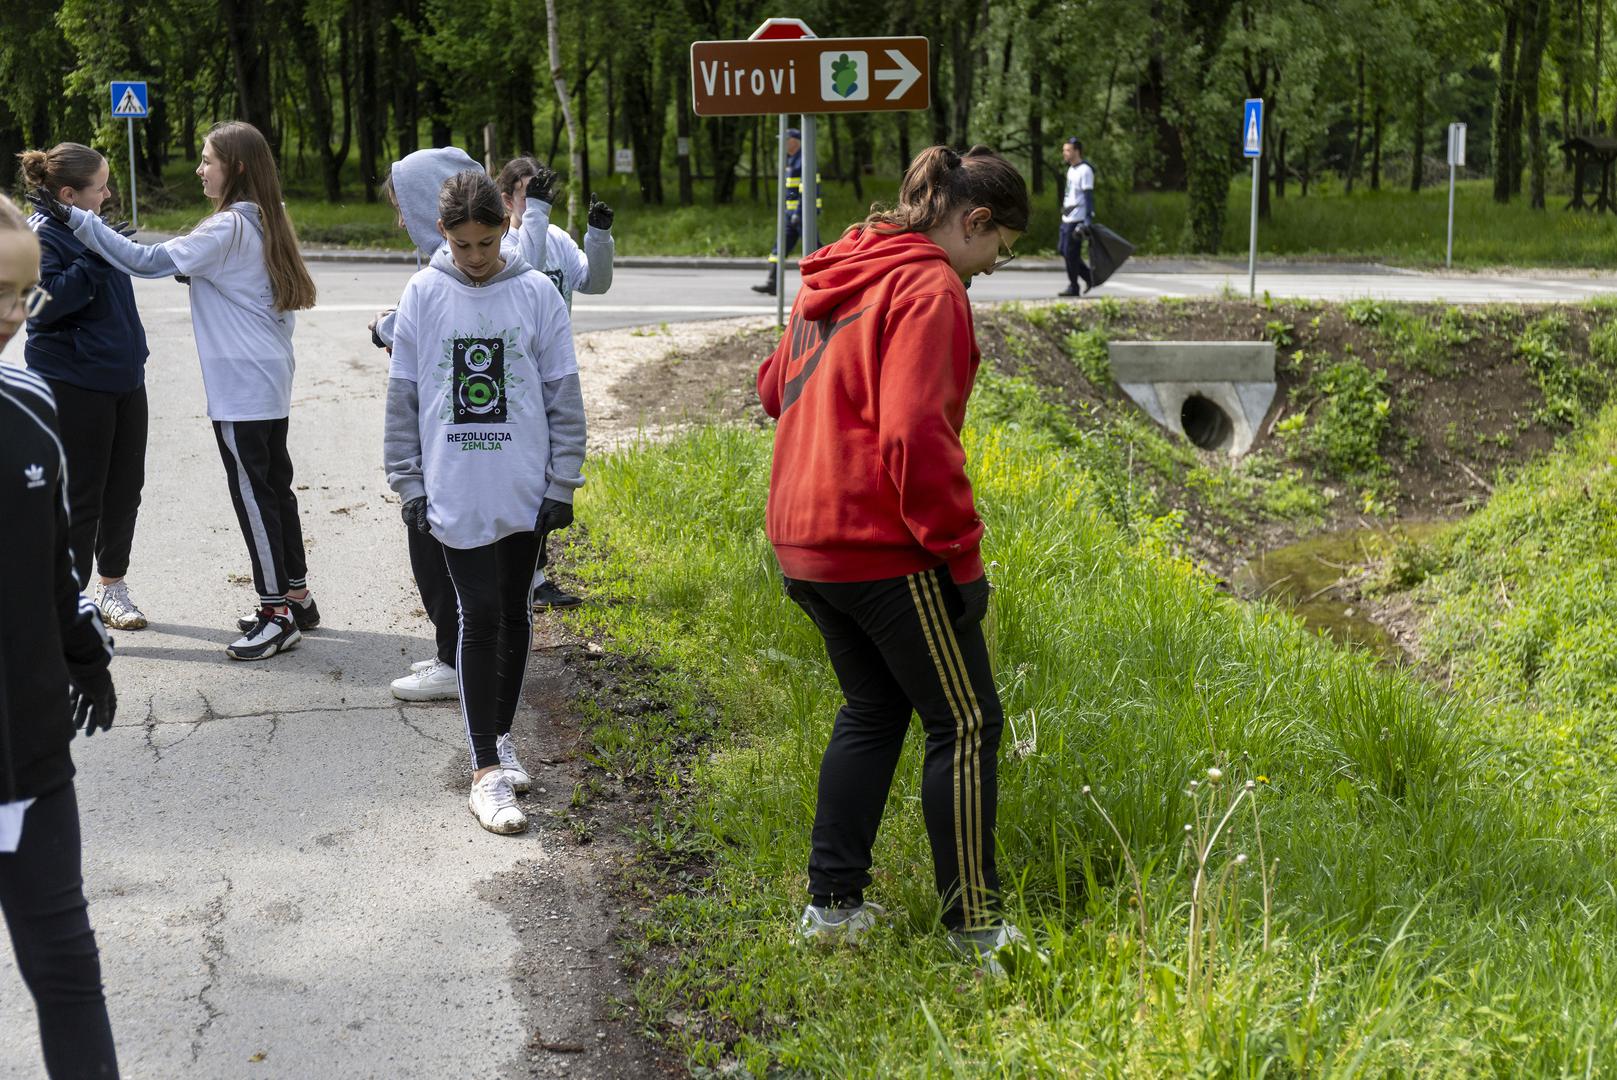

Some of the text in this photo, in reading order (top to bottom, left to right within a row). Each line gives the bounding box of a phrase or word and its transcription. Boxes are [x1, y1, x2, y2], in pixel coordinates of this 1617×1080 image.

[700, 60, 796, 96] Virovi
[447, 432, 512, 442] REZOLUCIJA
[461, 441, 502, 451] ZEMLJA
